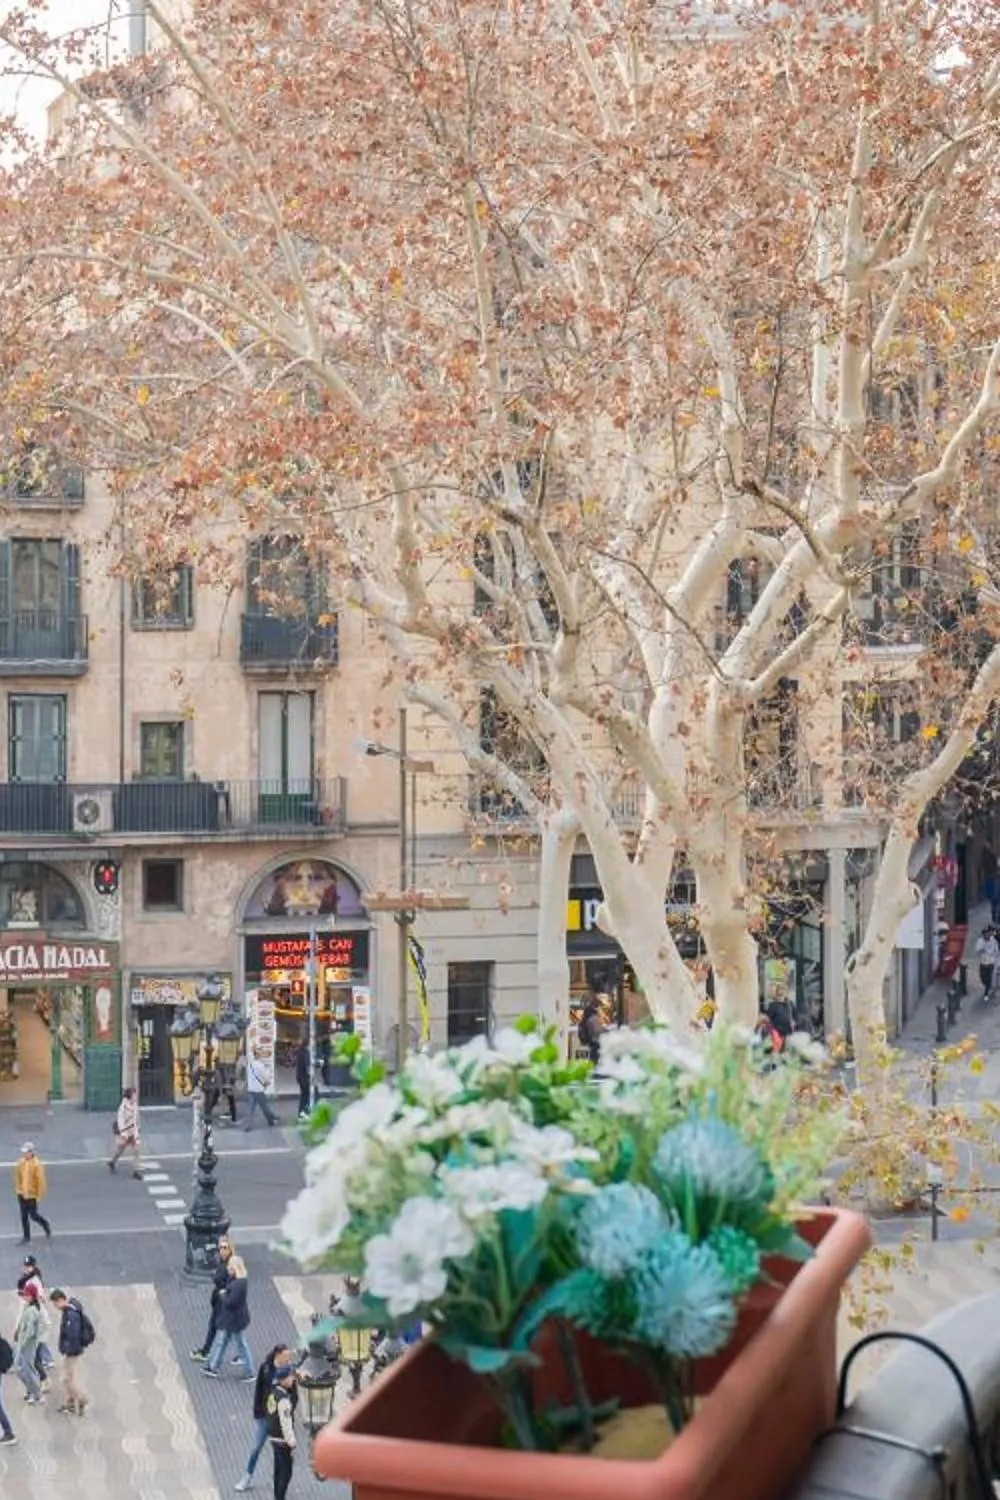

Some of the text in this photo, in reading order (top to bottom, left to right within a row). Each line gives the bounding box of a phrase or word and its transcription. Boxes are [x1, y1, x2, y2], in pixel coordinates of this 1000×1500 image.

[329, 938, 353, 950] CAN
[43, 945, 111, 969] NADAL
[264, 953, 350, 968] GEMÜS EBAB
